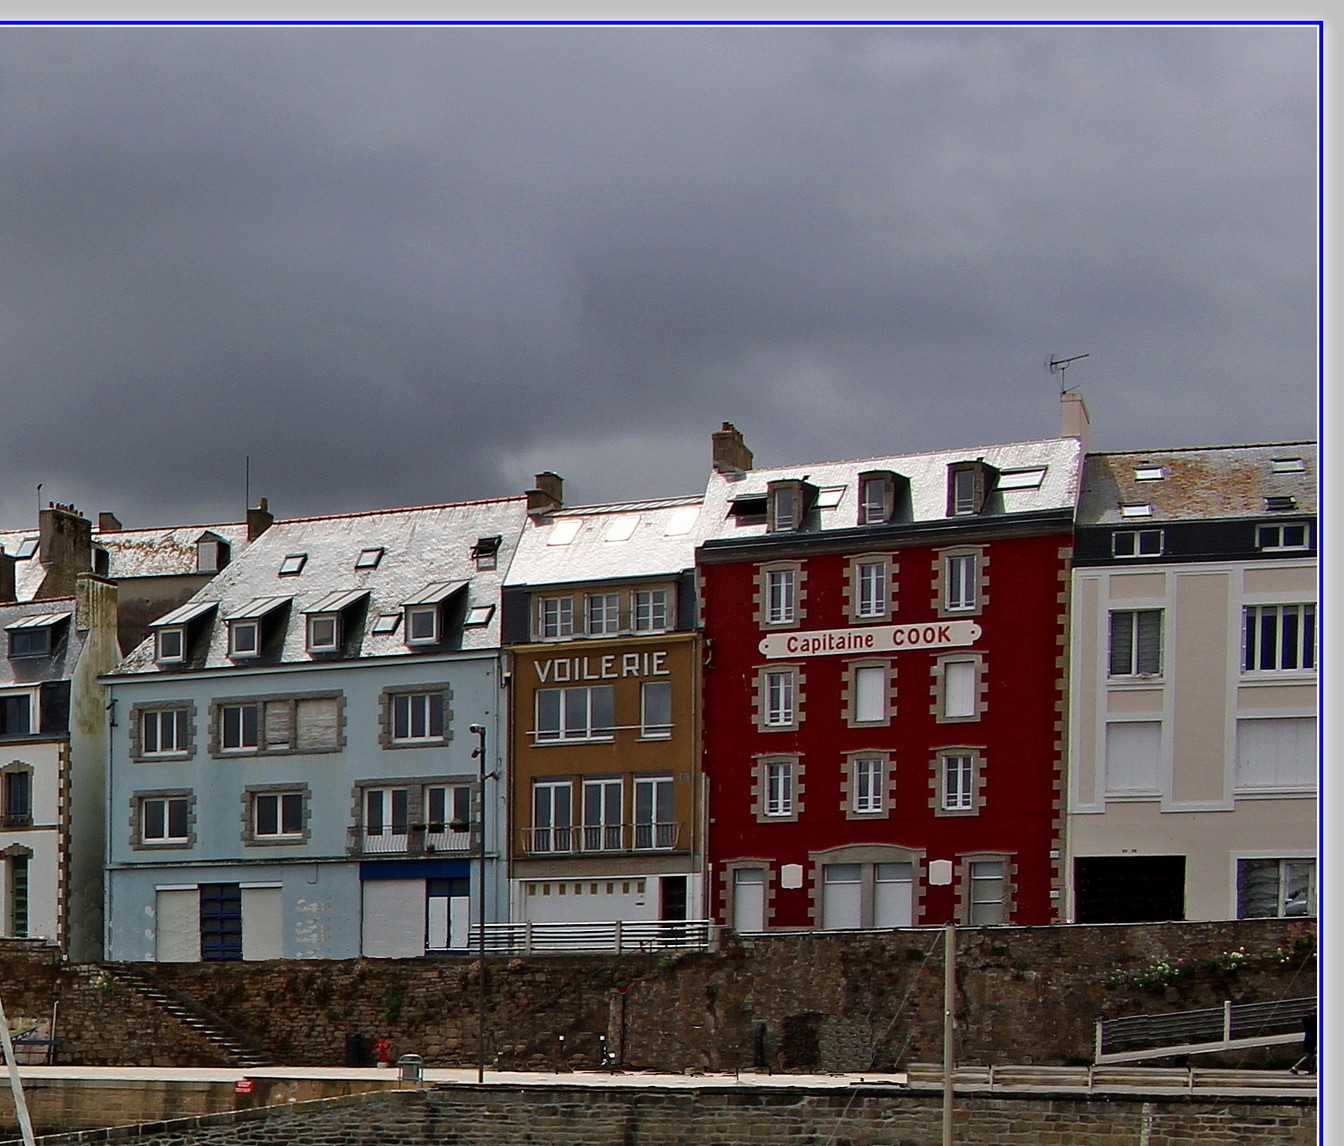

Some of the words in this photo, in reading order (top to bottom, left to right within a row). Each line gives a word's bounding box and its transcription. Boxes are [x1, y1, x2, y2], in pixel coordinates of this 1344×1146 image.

[786, 632, 875, 654] Capitaine
[892, 625, 952, 646] COOK
[533, 650, 671, 683] VOILERIE
